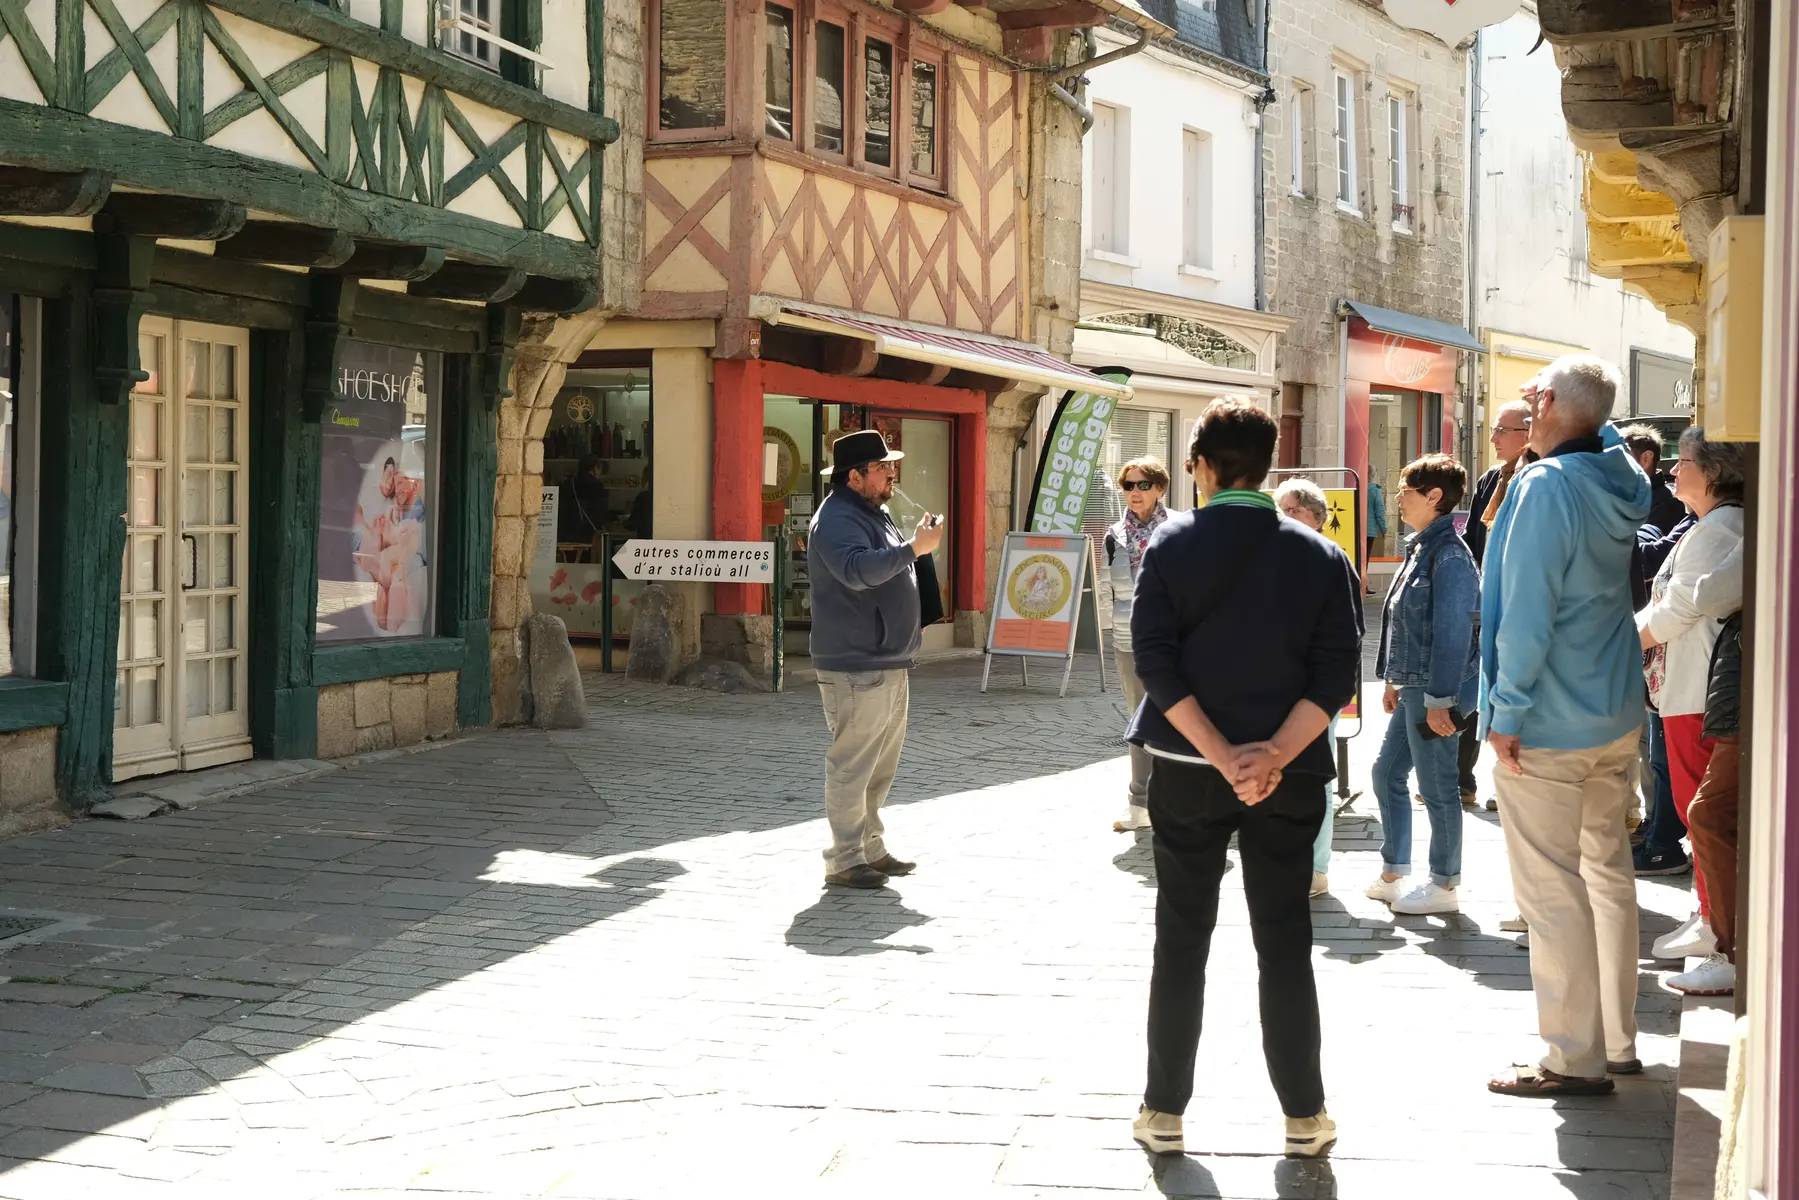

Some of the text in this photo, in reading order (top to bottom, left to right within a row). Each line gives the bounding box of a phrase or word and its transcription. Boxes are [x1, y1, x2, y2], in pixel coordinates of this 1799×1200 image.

[1049, 395, 1112, 534] Massage
[634, 546, 770, 560] autres commerces
[670, 563, 722, 577] stalioù
[730, 564, 750, 577] all
